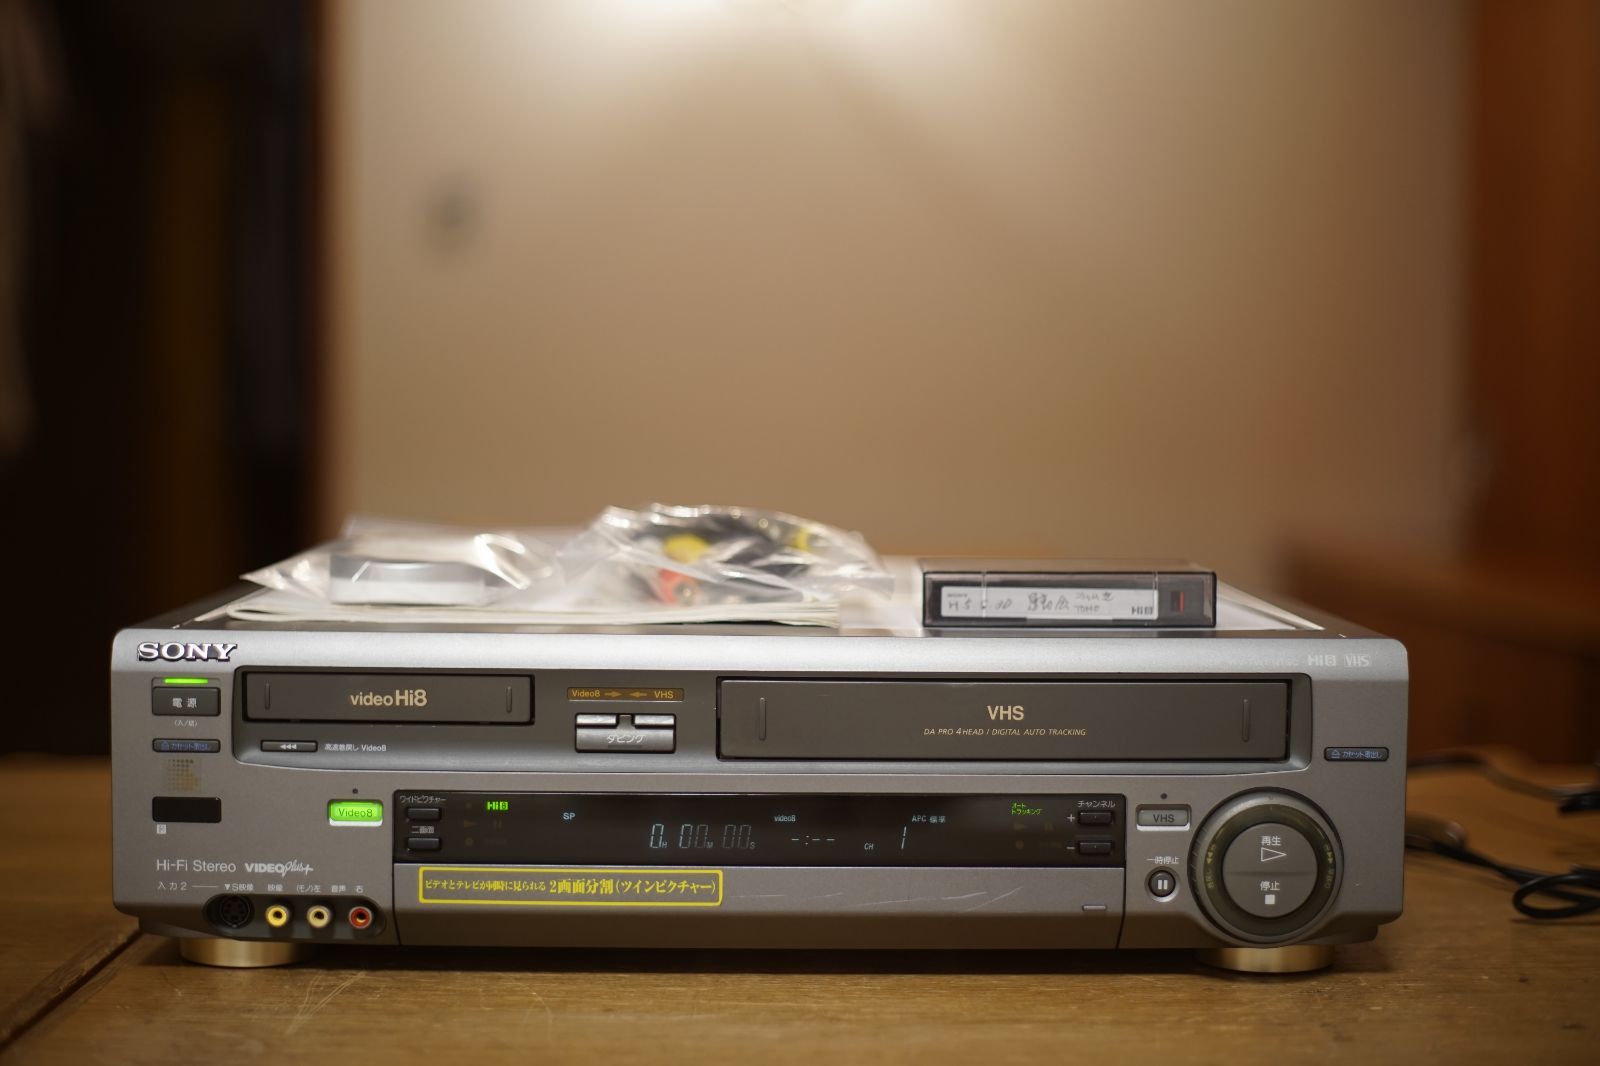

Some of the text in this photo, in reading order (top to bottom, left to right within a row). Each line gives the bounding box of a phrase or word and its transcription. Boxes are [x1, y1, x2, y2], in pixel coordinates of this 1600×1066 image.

[137, 642, 238, 663] SONY
[572, 689, 674, 699] Video8 VHS
[987, 705, 1025, 721] VHS
[923, 728, 935, 736] DA
[938, 728, 954, 736] PRO
[991, 728, 1021, 736] DIGITAL
[1023, 728, 1046, 736] AUTO
[1048, 728, 1087, 736] TRACKING
[1077, 799, 1116, 809] チャンネル
[338, 807, 373, 819] Video8
[562, 812, 576, 821] SP
[1153, 813, 1175, 824] VHS
[1261, 835, 1281, 846] 再生
[863, 842, 875, 850] CH
[156, 859, 188, 872] Hi-Fi
[192, 859, 237, 873] Stereo
[1259, 881, 1281, 891] 停止
